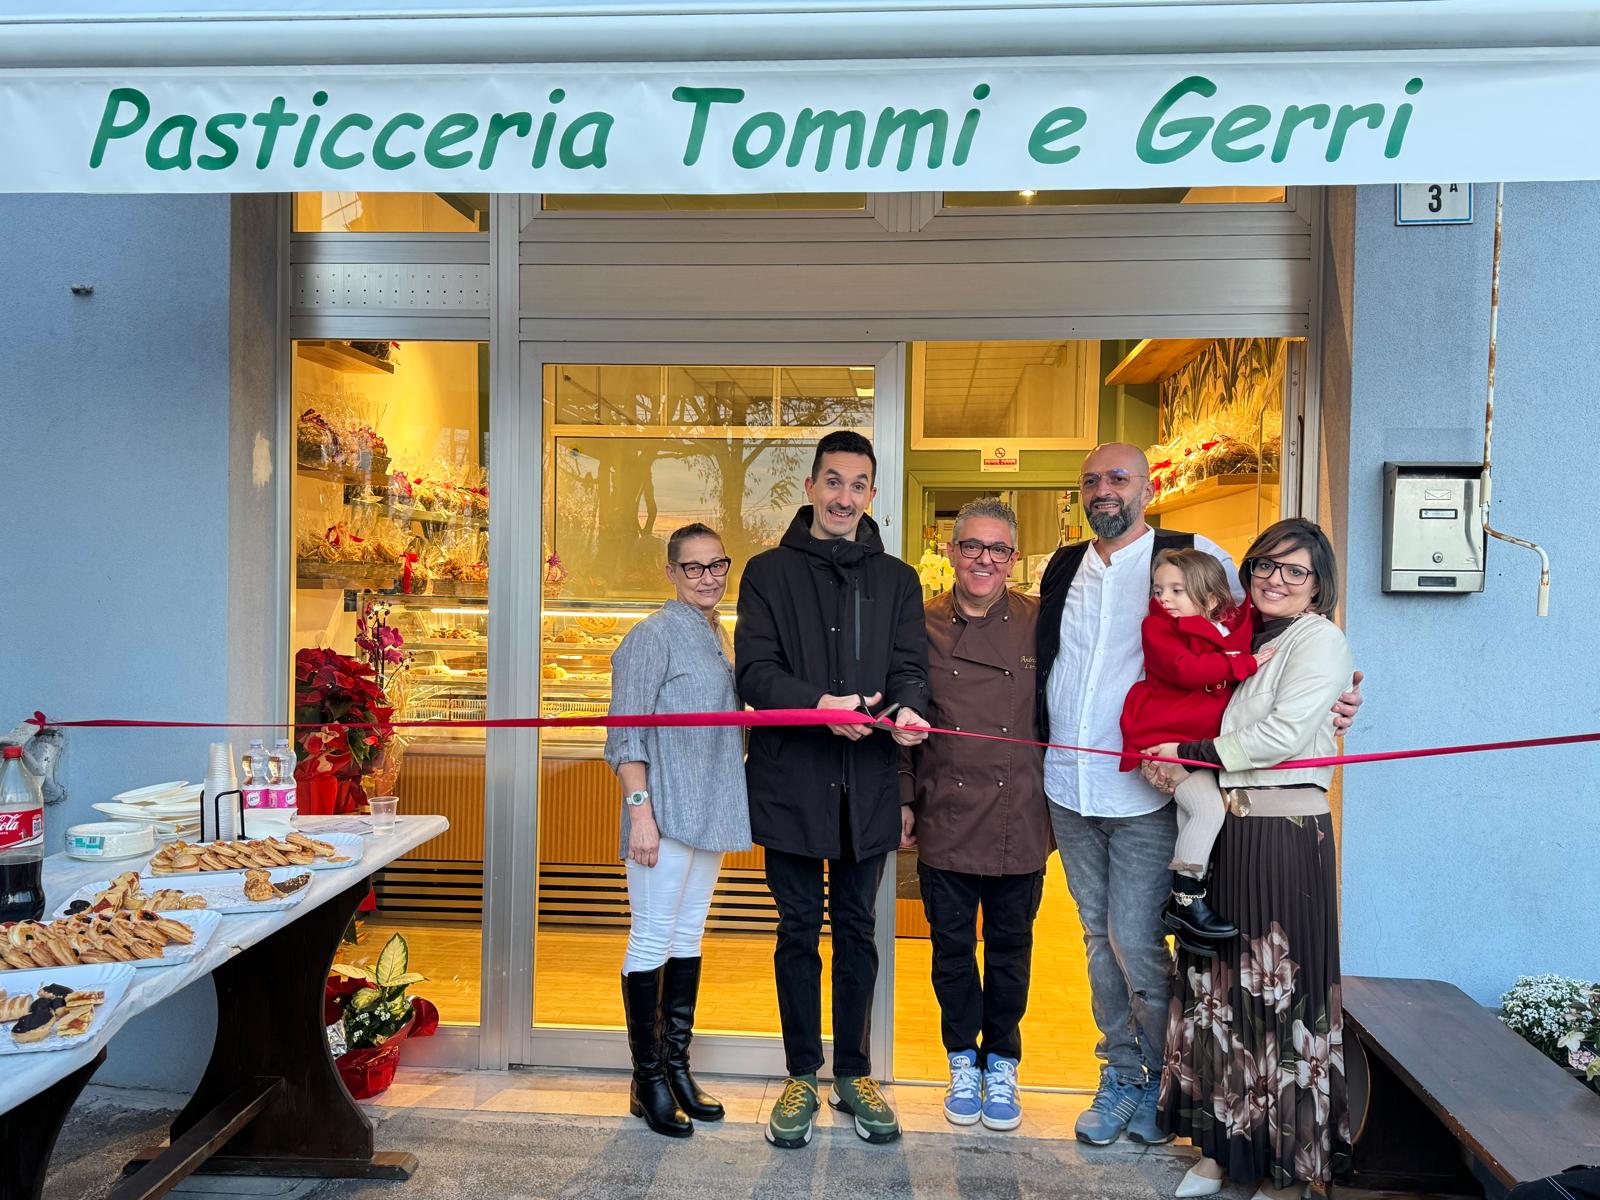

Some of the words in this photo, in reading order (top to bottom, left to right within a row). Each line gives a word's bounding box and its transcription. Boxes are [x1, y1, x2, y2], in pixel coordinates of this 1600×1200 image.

[89, 87, 615, 171] Pasticceria
[671, 83, 991, 173] Tommi
[1027, 106, 1087, 165] e
[1135, 75, 1424, 165] Gerri
[1428, 184, 1442, 213] 3
